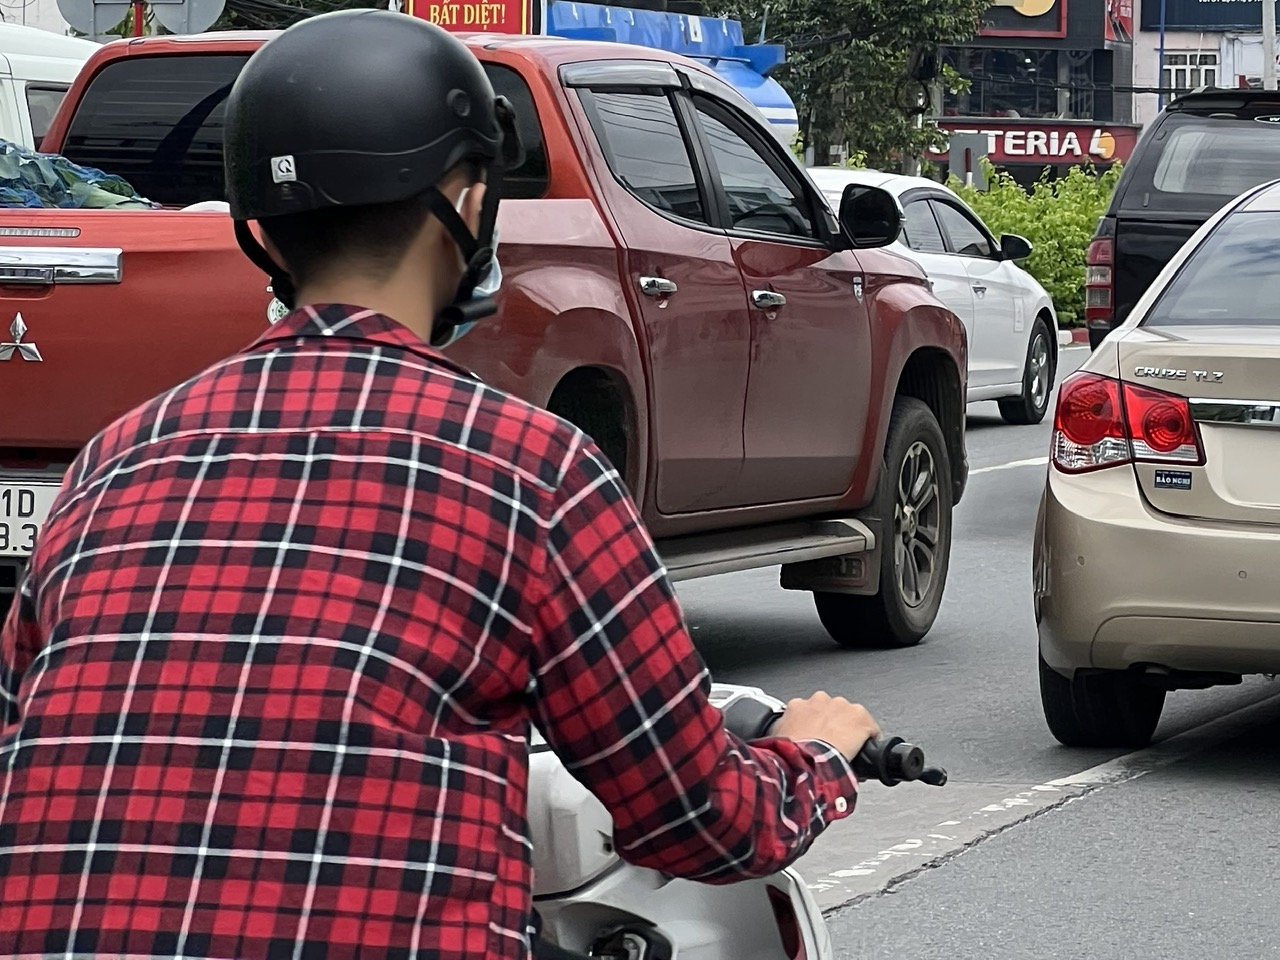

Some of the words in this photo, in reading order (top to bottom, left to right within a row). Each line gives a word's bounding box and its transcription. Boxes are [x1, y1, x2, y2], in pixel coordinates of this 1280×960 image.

[1134, 366, 1187, 381] CRUZE
[1156, 474, 1171, 484] BẢO
[2, 489, 35, 517] 1D
